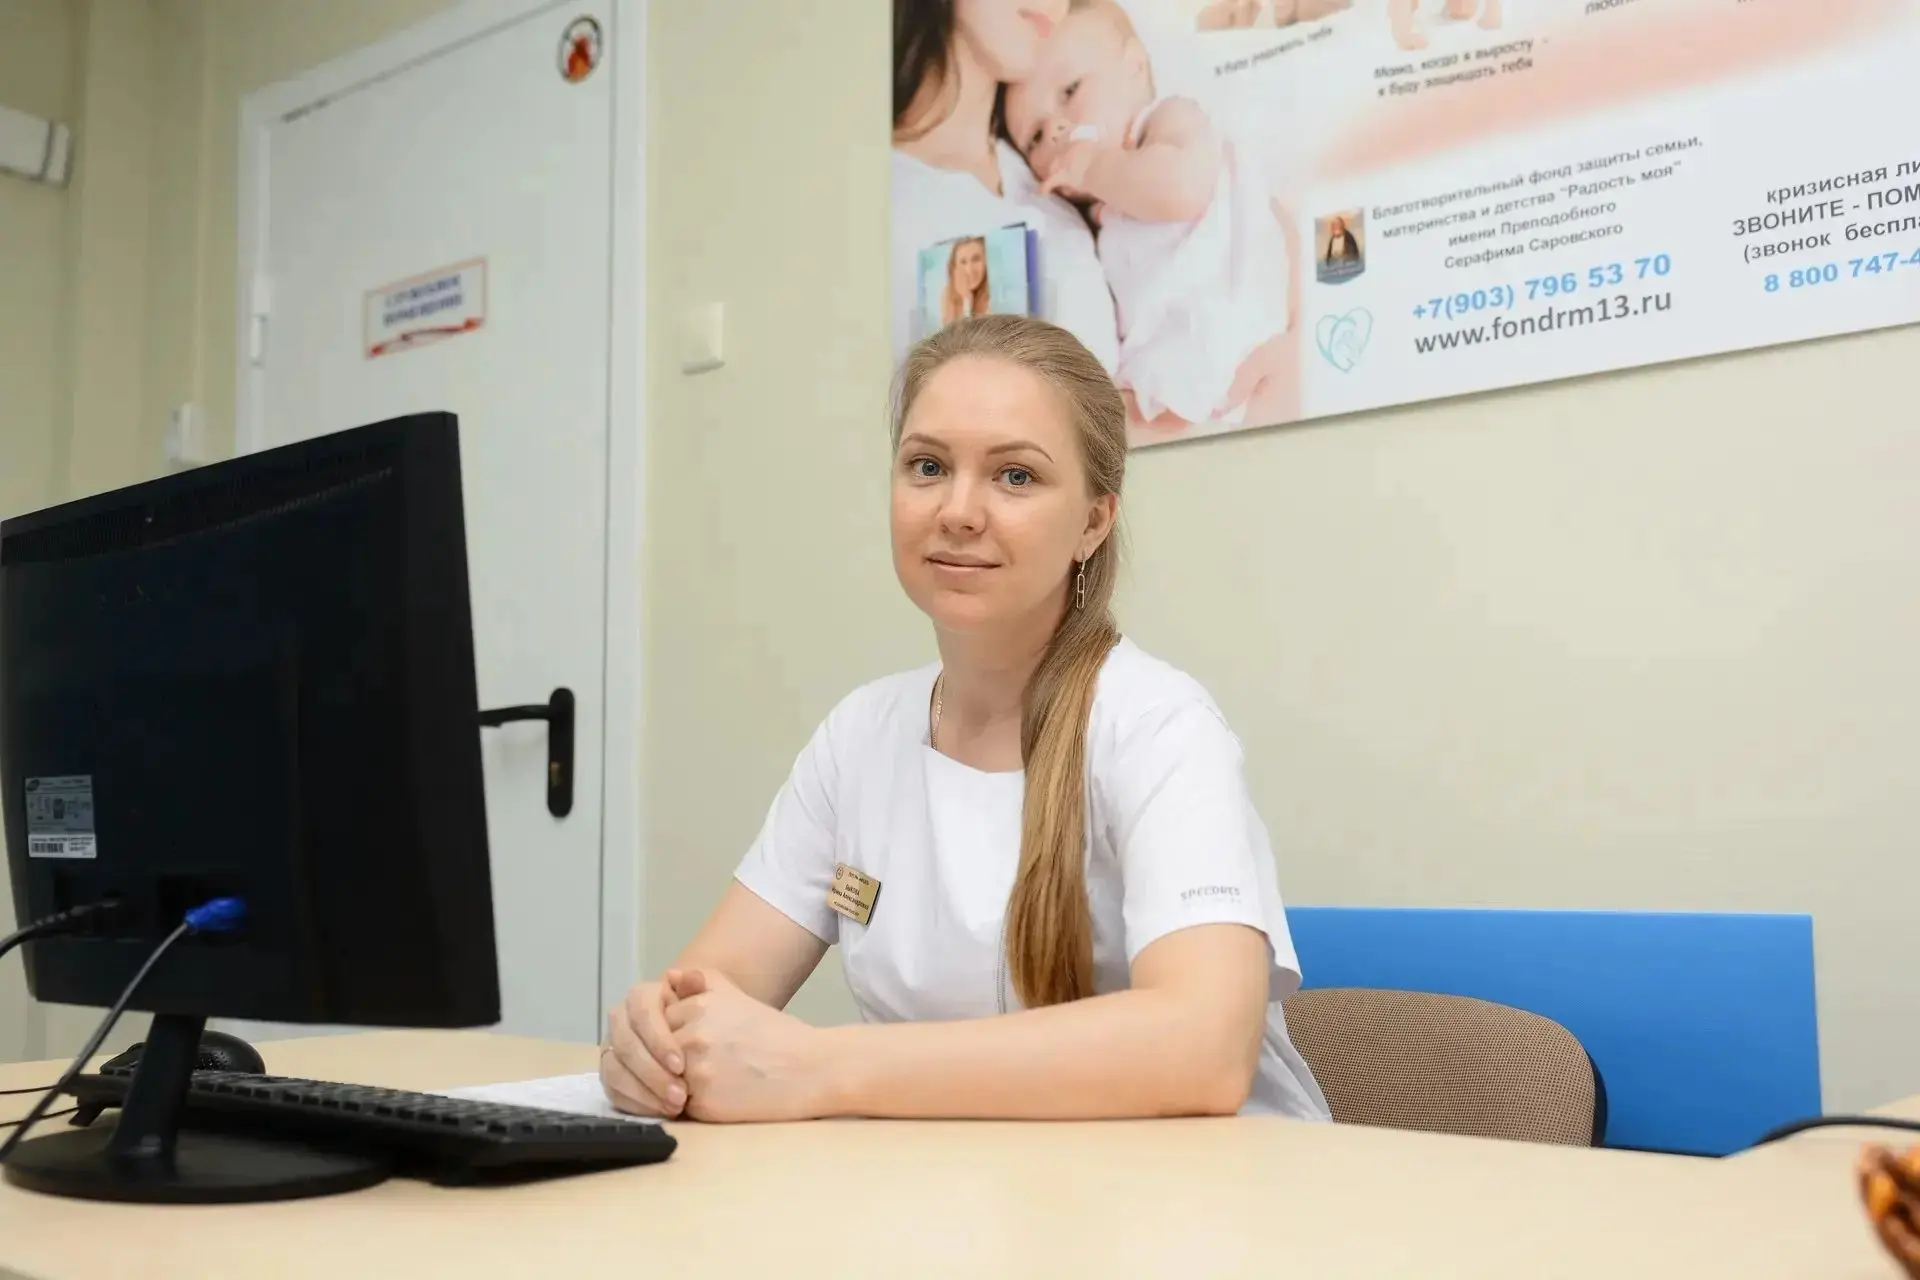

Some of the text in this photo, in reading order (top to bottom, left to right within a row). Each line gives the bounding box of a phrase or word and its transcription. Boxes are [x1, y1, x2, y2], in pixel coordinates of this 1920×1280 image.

[1371, 136, 1704, 221] Благотворительный фонд защиты семьи,
[1766, 166, 1889, 205] кризисная
[1382, 208, 1477, 240] материнства
[1481, 205, 1491, 218] и
[1494, 190, 1556, 216] детства
[1447, 201, 1617, 248] имени Преподобного
[1732, 198, 1846, 237] ЗВОНИТЕ
[1866, 183, 1920, 211] ПОМ
[1443, 222, 1624, 270] Серафима Саровского
[1743, 216, 1920, 264] (звонок беспл
[1411, 252, 1672, 322] +7(903) 796 53 70
[1763, 247, 1920, 294] 8 800 747-4
[1414, 290, 1673, 355] www.fondrm13.ru
